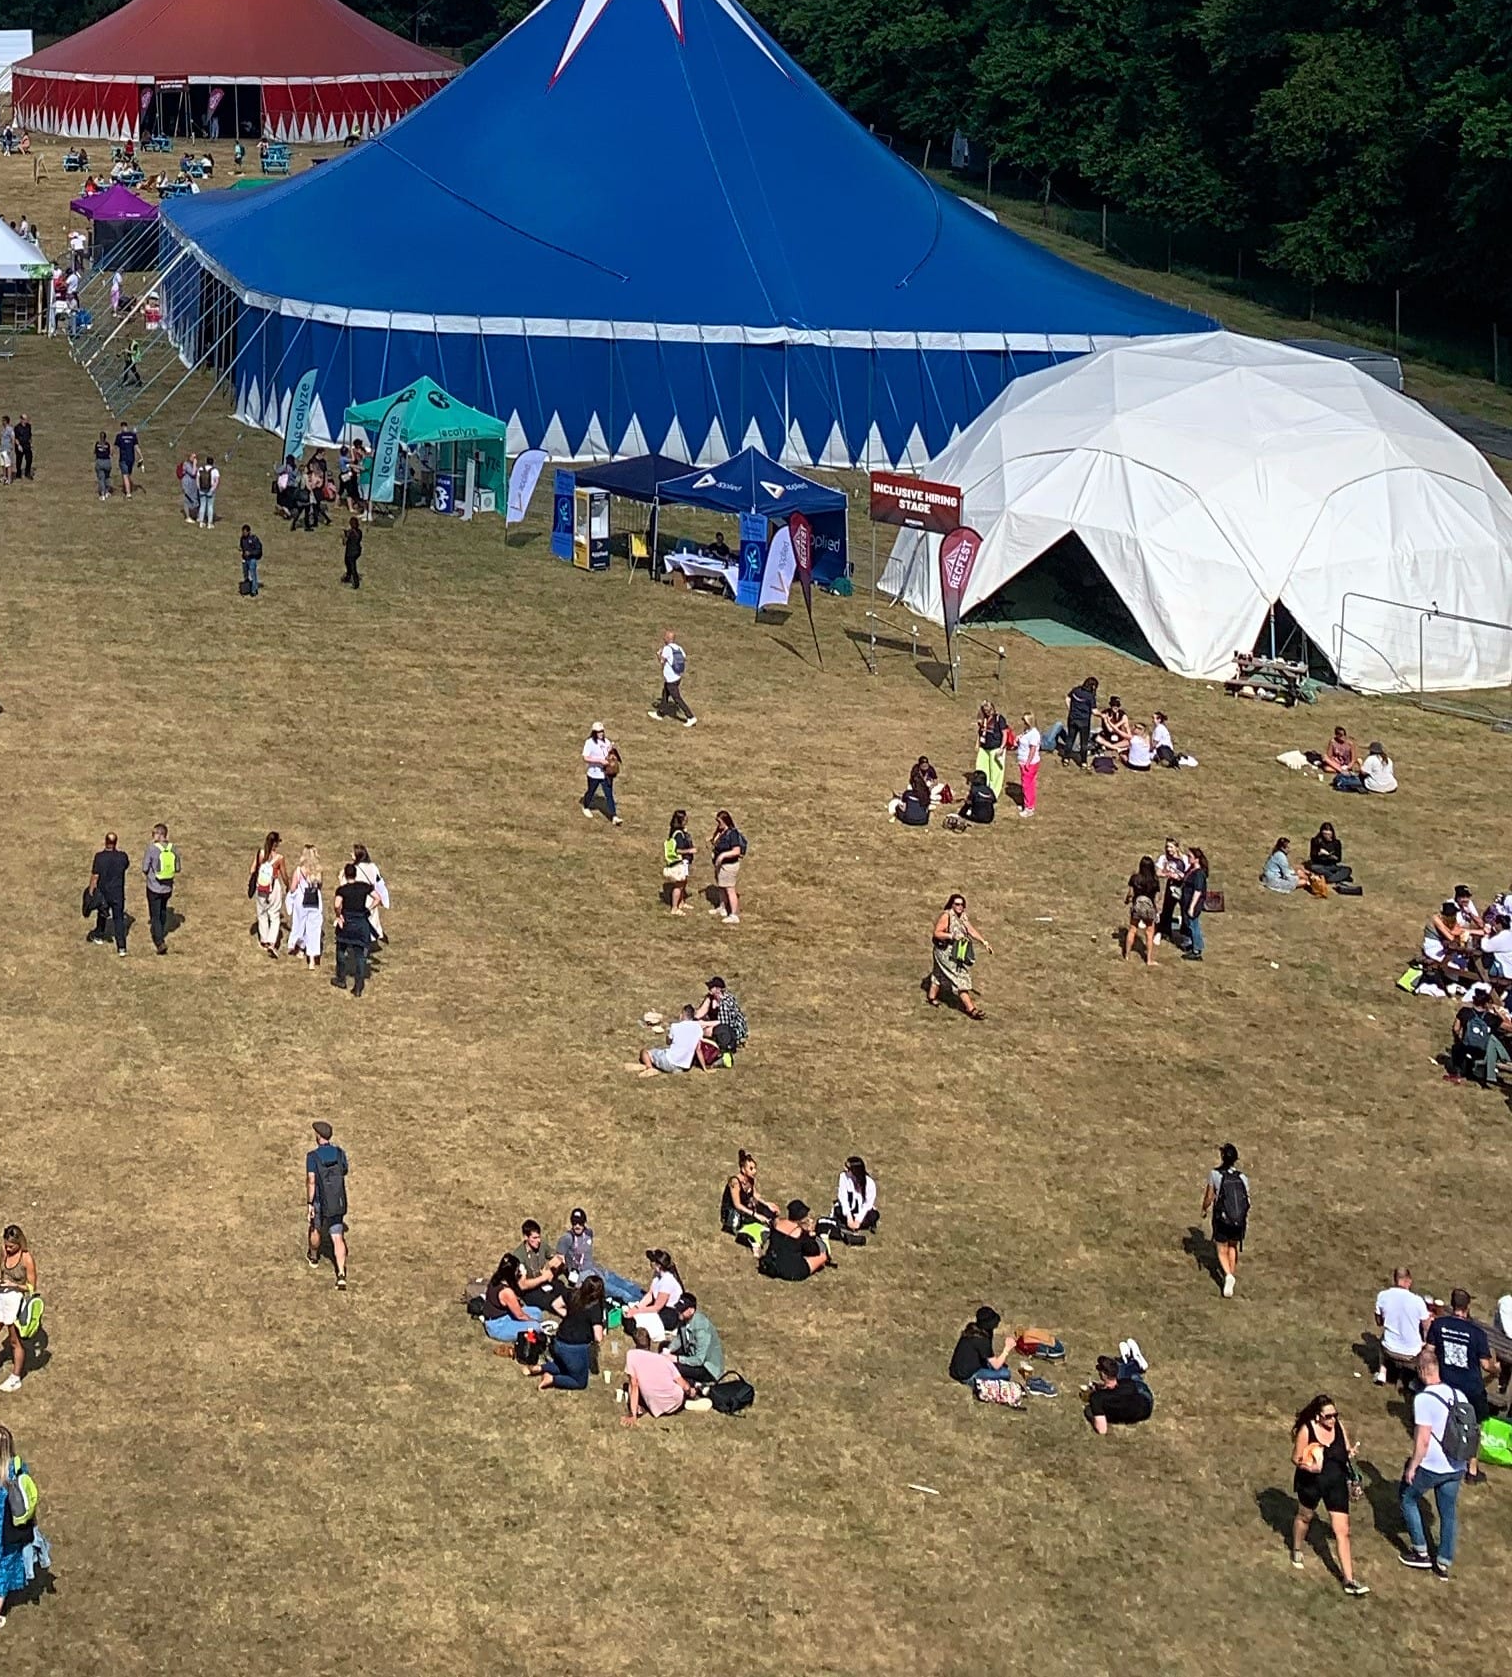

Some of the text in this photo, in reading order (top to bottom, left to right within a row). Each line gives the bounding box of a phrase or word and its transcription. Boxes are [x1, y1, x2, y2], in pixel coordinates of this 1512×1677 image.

[873, 482, 958, 507] INCLUSIVE HIRING
[899, 499, 931, 514] STAGE
[949, 540, 973, 589] RECFEST
